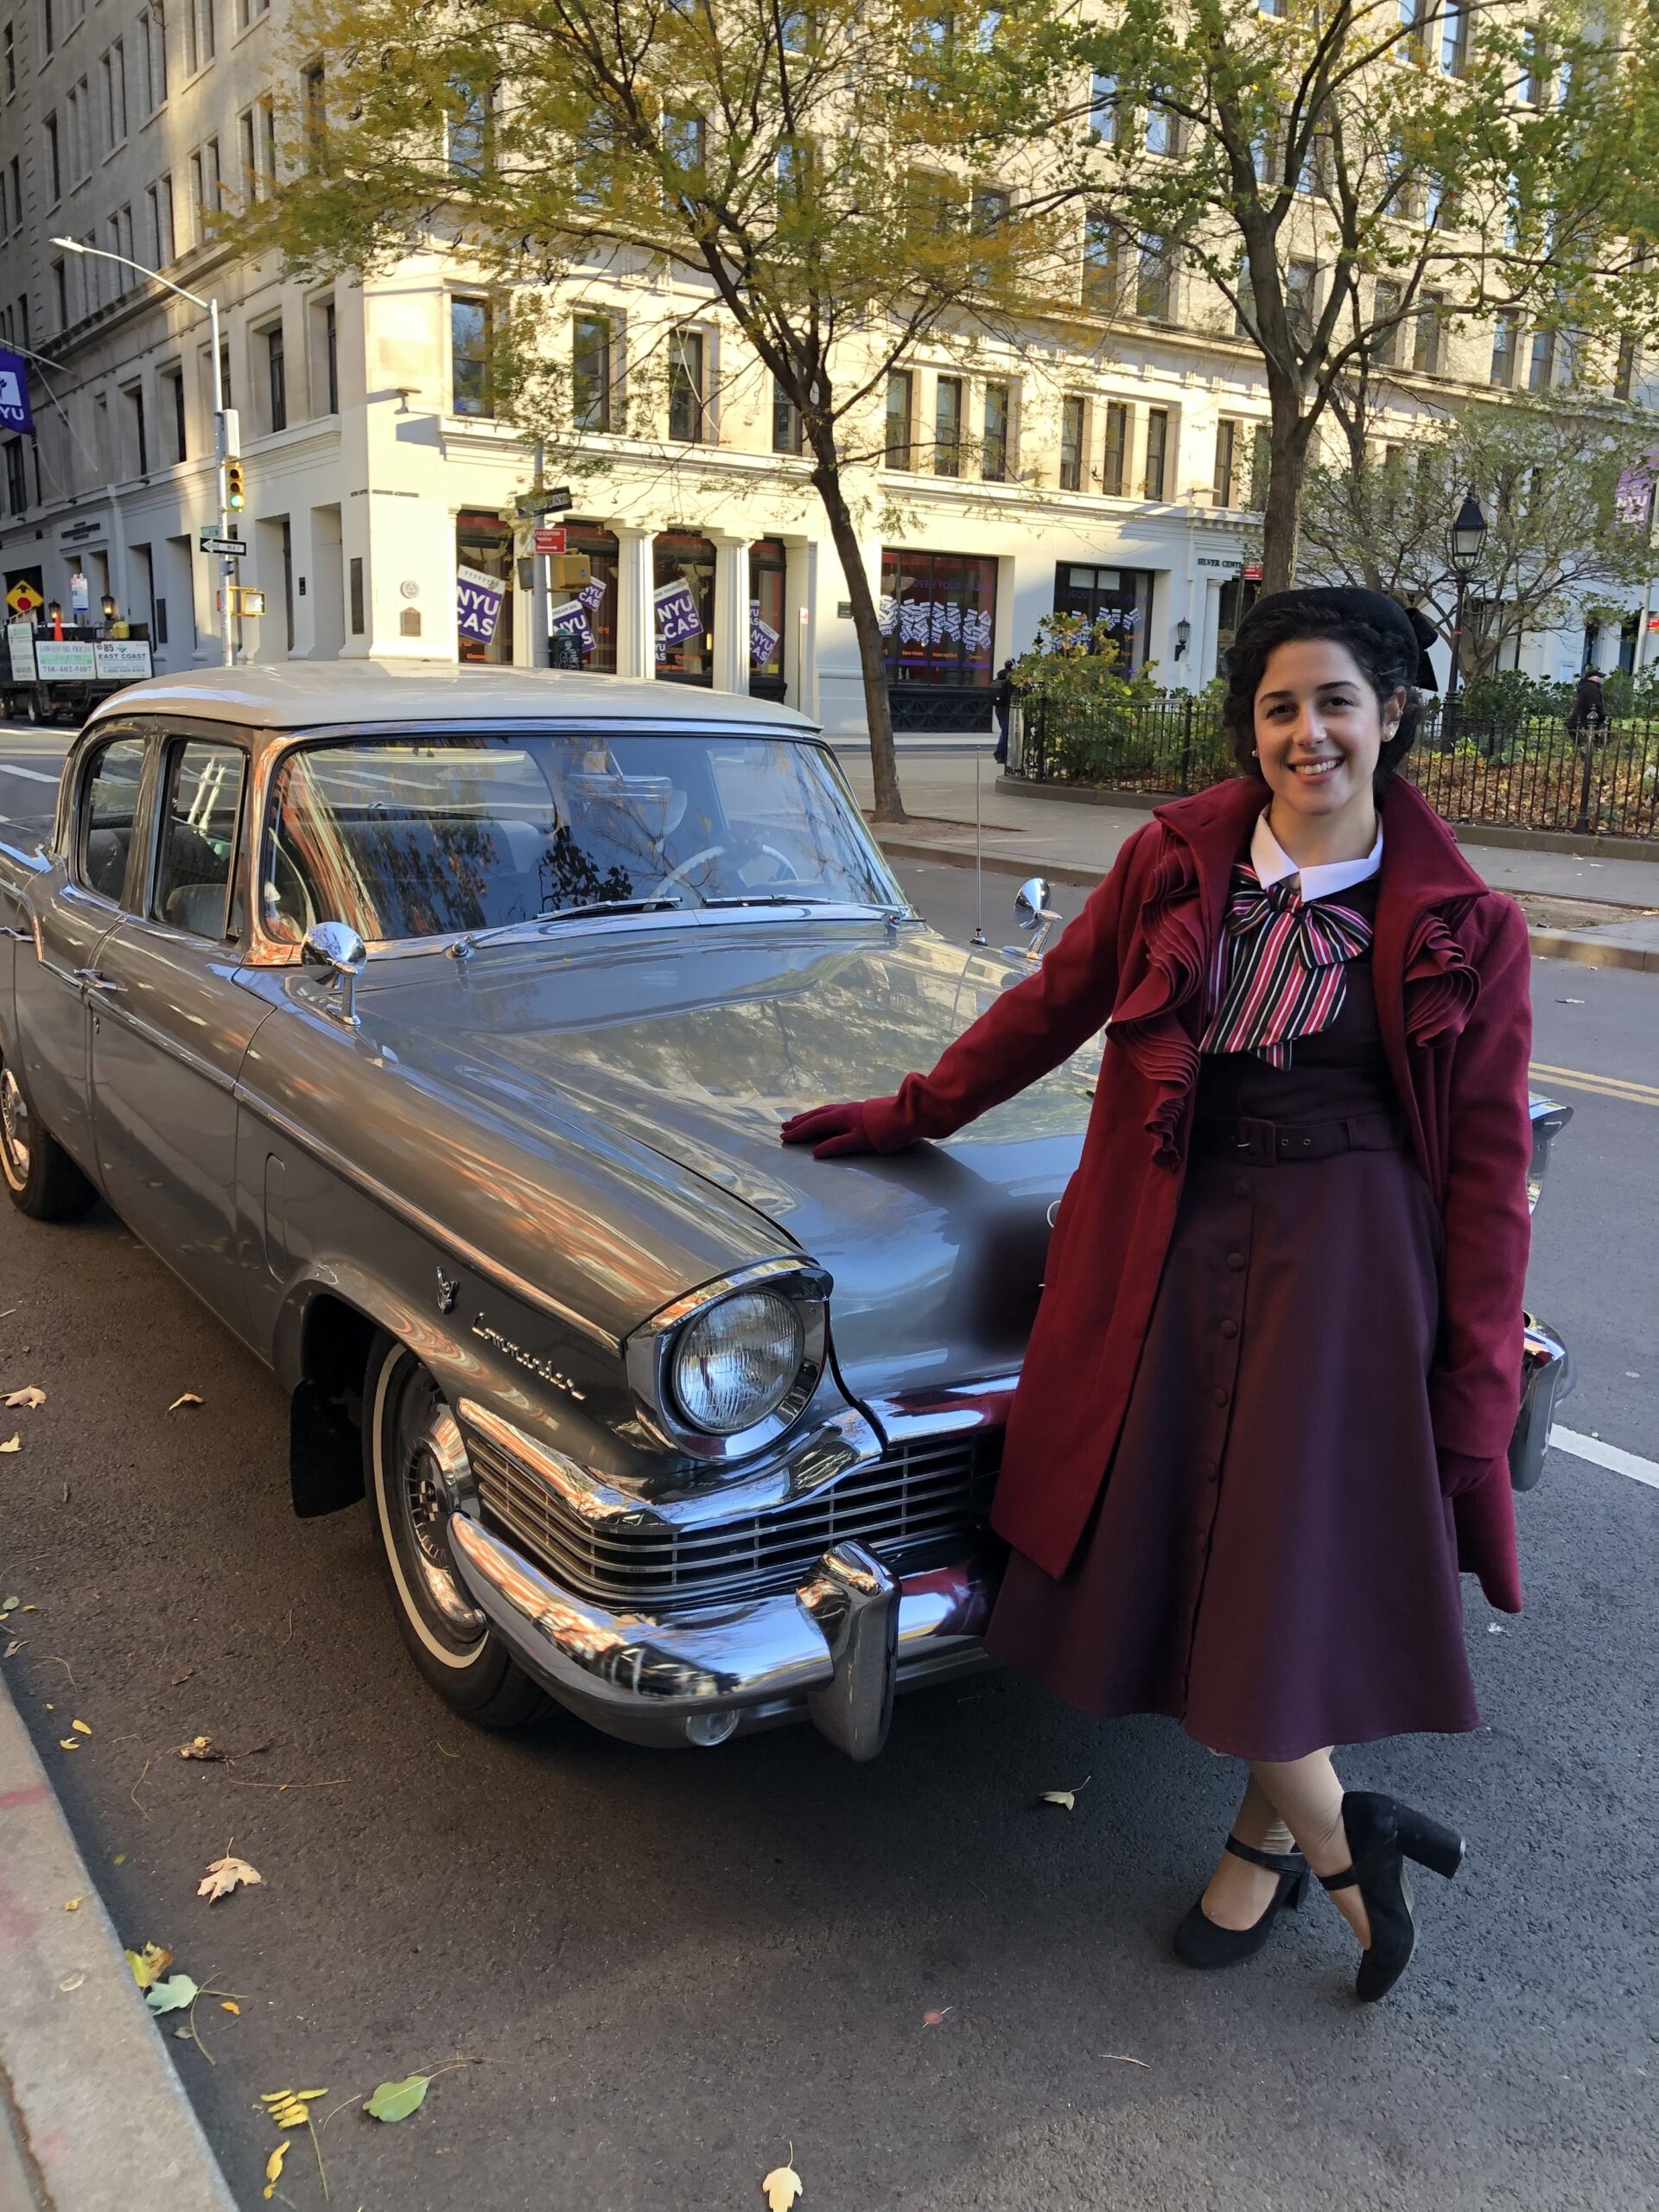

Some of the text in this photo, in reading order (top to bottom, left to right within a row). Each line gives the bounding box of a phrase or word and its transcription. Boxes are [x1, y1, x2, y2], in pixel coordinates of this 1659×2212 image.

[0, 406, 24, 420] YU
[457, 586, 499, 615] NYU
[579, 592, 600, 607] CAS
[657, 594, 693, 623] NYU
[664, 613, 699, 639] CAS
[104, 644, 114, 652] 85
[655, 643, 665, 652] YU
[751, 630, 773, 652] NYU
